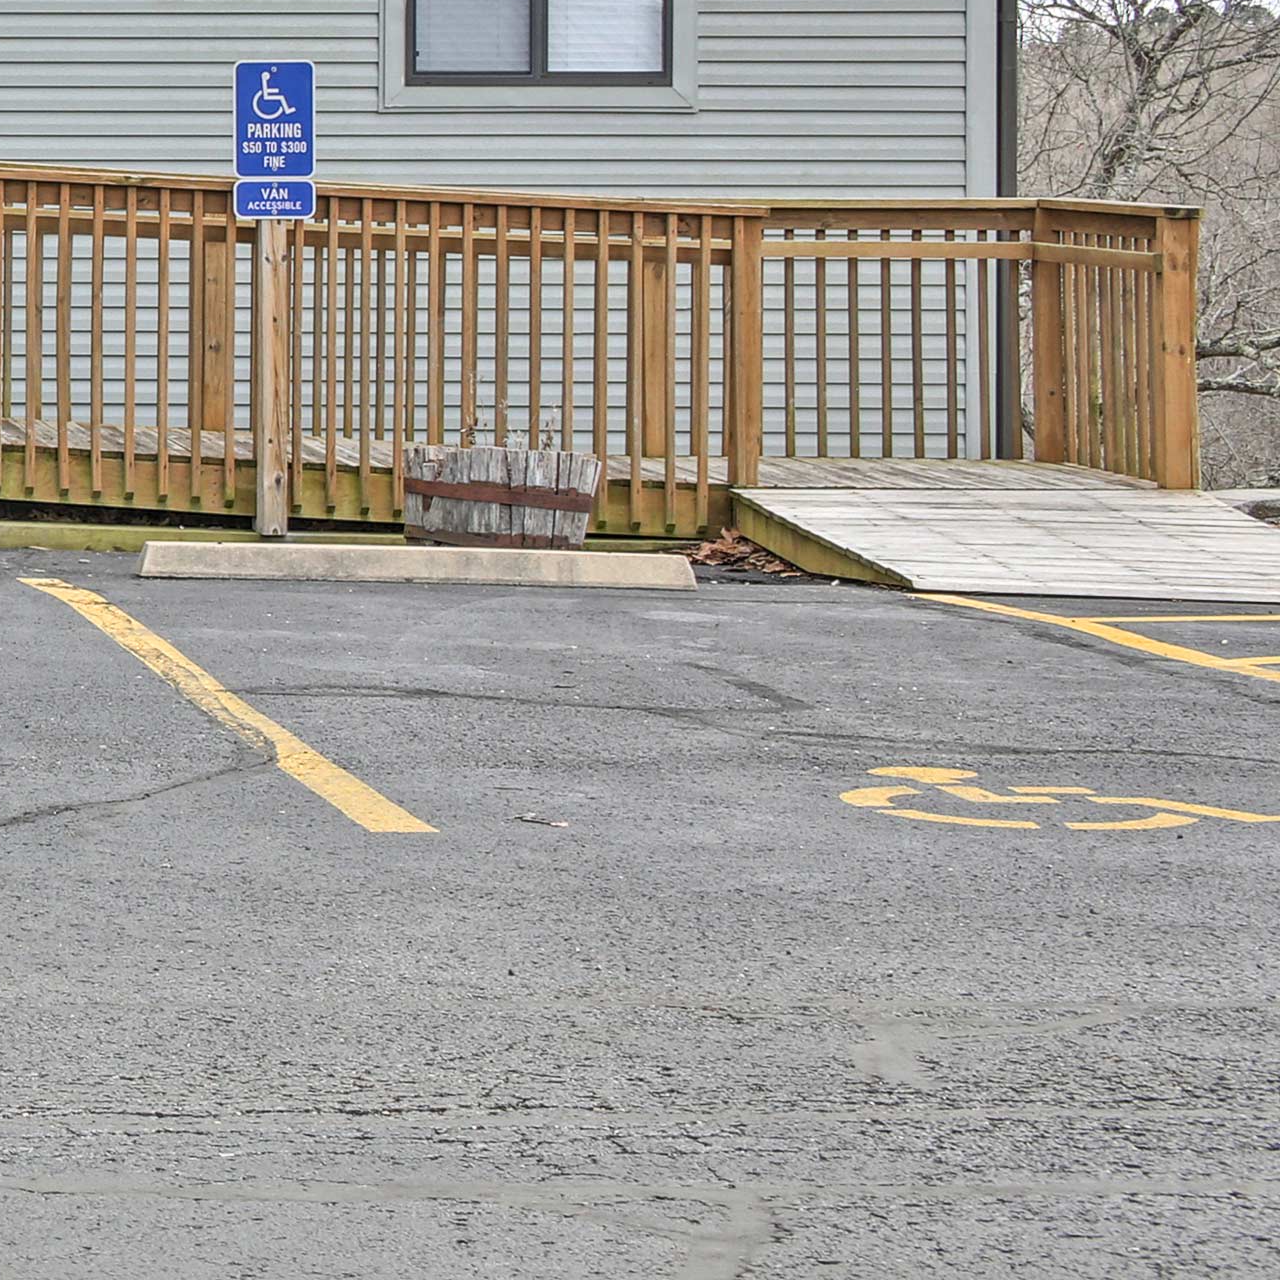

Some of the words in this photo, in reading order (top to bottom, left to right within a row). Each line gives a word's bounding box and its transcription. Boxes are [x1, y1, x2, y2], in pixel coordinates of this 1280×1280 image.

[246, 122, 303, 139] PARKING
[242, 140, 263, 154] $50
[264, 141, 278, 154] TO
[280, 140, 308, 154] $300
[263, 155, 286, 168] FINE
[260, 187, 289, 200] VAN
[246, 200, 303, 210] ACCESSIBLE
